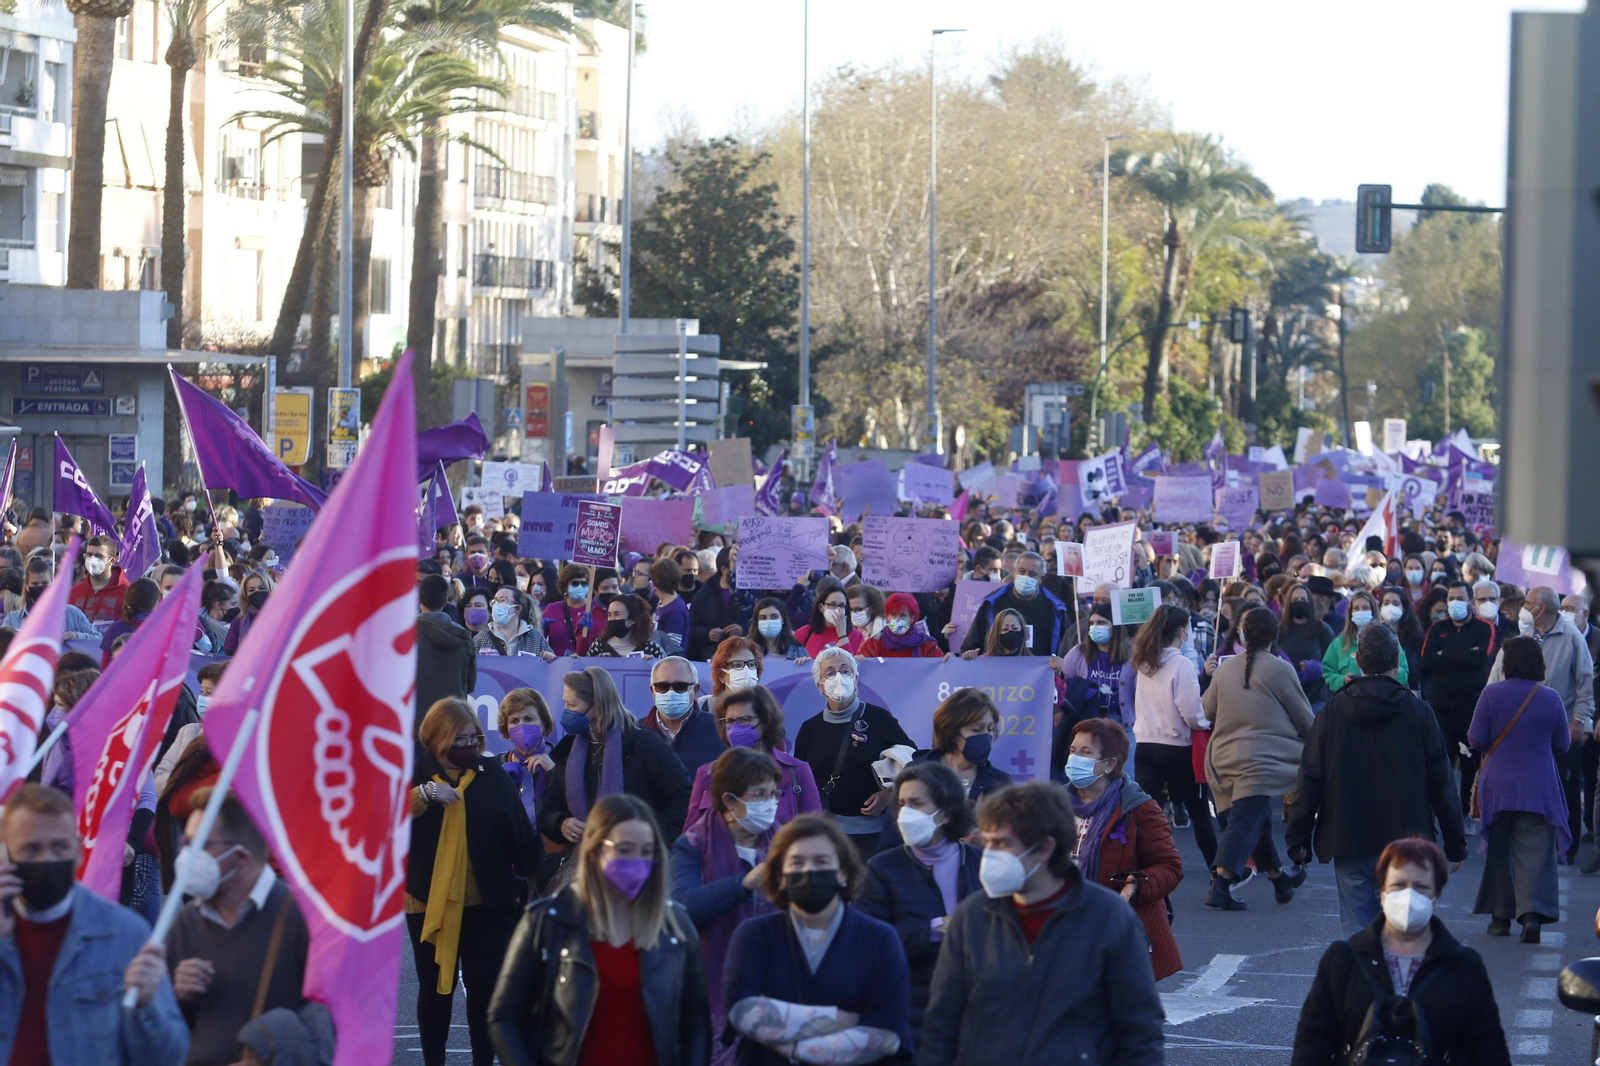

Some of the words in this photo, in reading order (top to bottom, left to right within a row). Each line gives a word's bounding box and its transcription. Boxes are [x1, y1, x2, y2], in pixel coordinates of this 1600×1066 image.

[27, 366, 40, 382] P
[37, 402, 90, 413] ENTRADA
[279, 438, 294, 459] P
[1266, 485, 1285, 496] NO
[587, 519, 610, 530] SOMOS
[587, 545, 607, 556] MUNDO
[929, 557, 937, 566] NO
[997, 714, 1036, 736] 022
